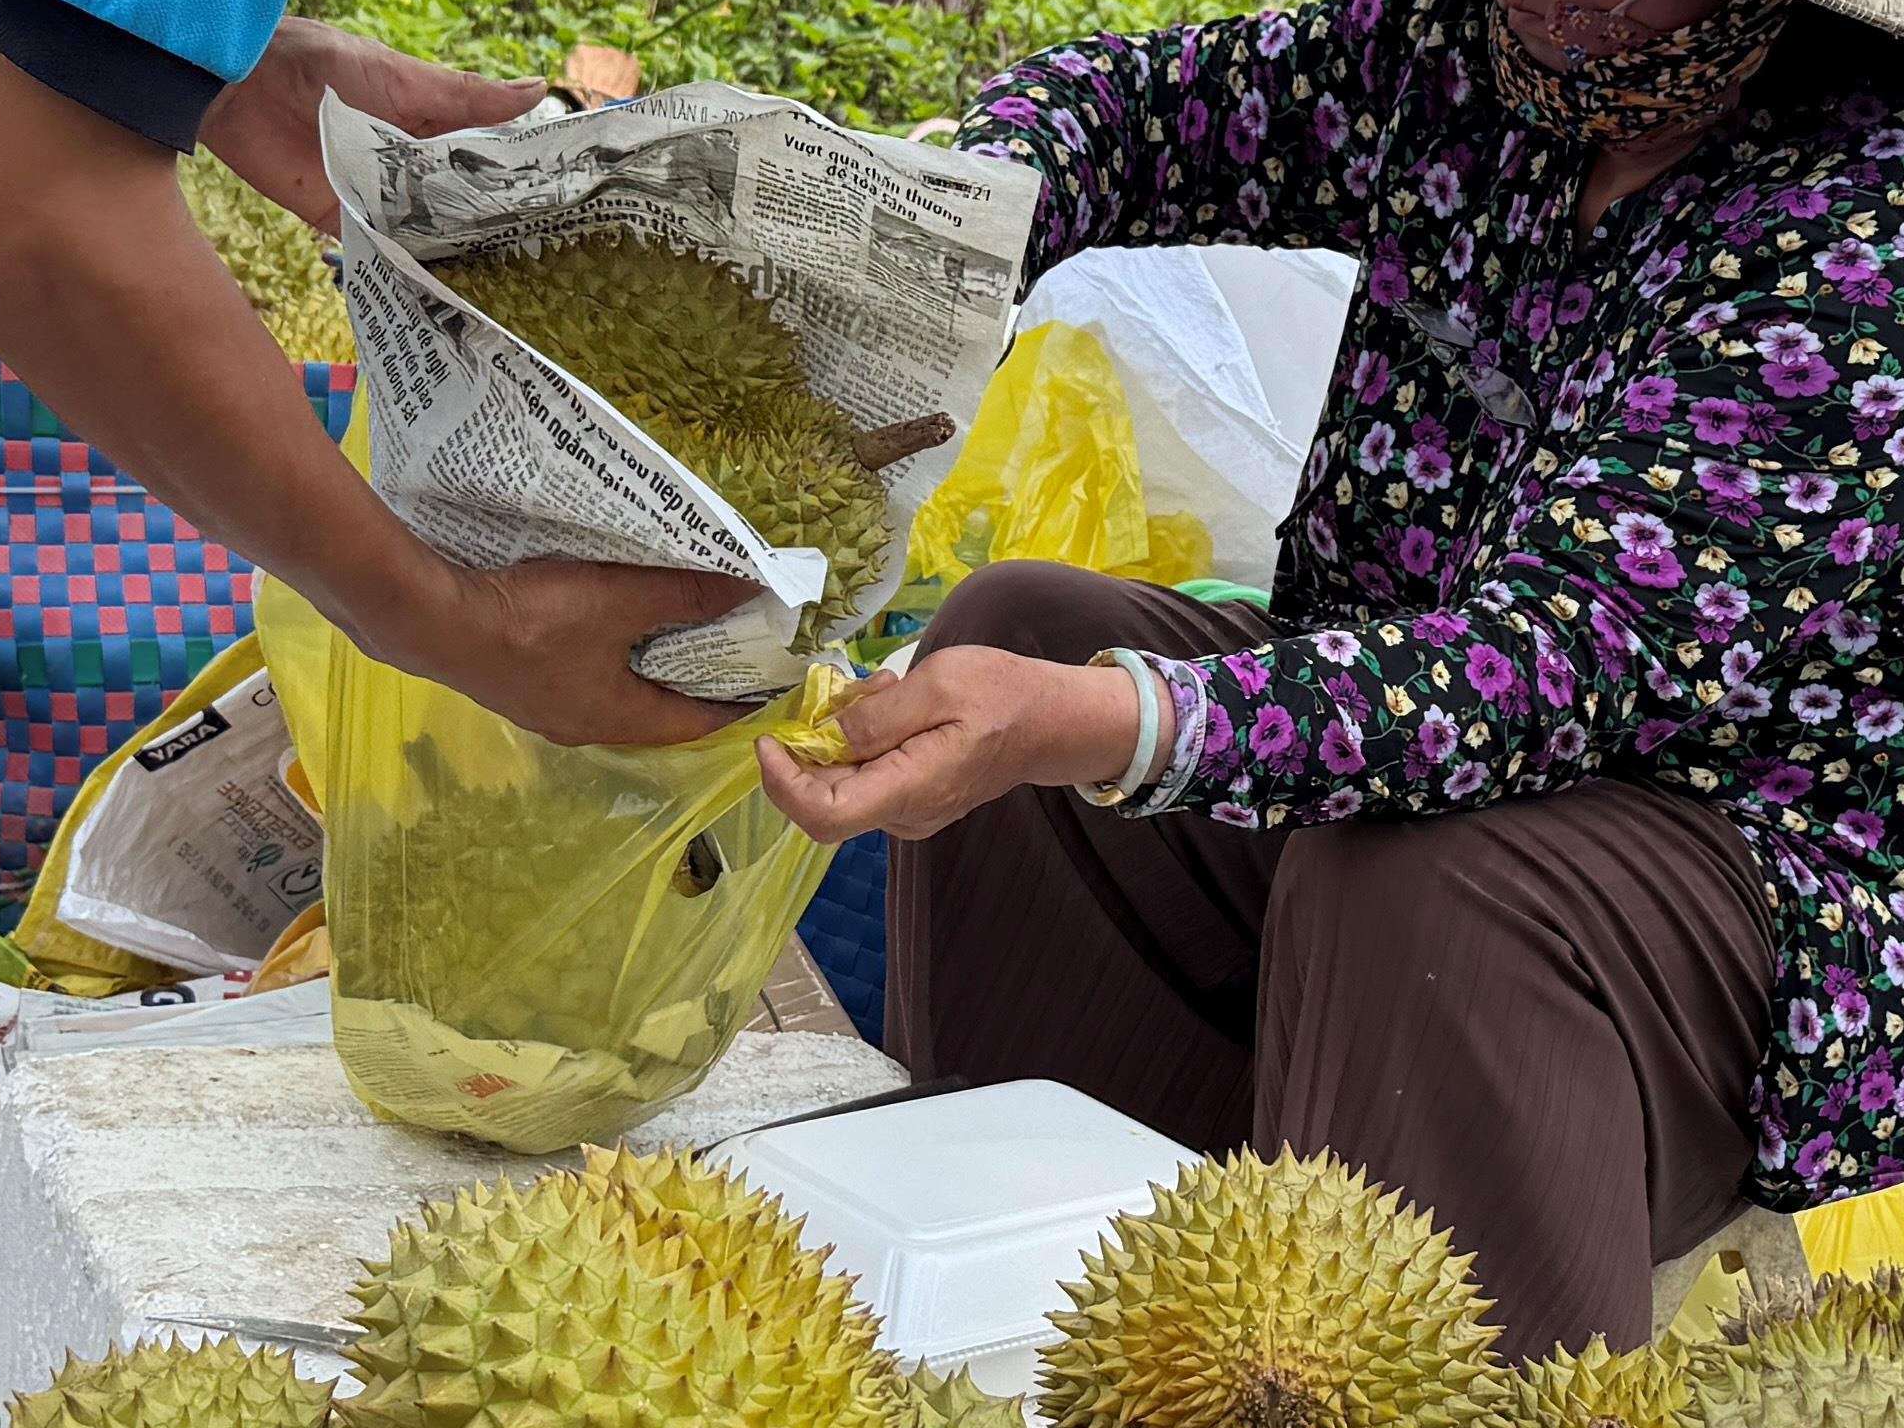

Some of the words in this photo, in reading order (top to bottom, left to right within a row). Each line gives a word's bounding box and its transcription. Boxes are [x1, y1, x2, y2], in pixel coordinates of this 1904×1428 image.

[546, 416, 596, 471] ngầm
[595, 462, 625, 493] tại
[648, 470, 685, 513] tiếp
[680, 500, 712, 537] tục
[147, 723, 218, 763] YARA
[216, 780, 315, 852] EXCELLENCE
